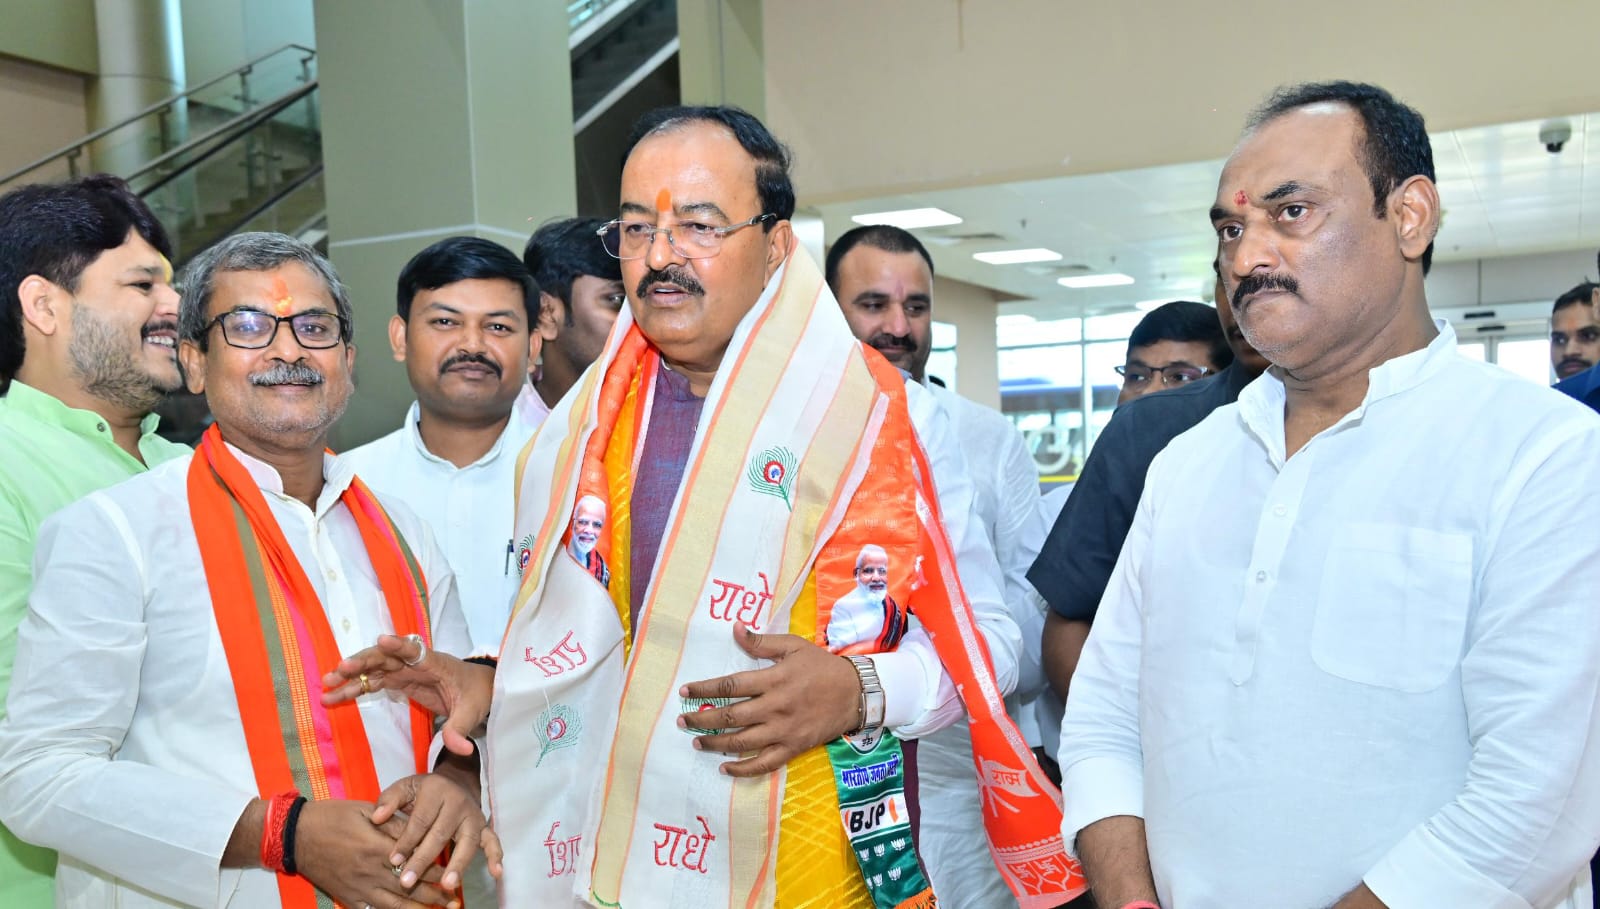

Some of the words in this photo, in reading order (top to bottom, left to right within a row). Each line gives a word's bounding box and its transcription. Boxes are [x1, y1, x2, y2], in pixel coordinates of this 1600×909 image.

[709, 571, 774, 630] राधे
[842, 764, 869, 788] भारतीय
[850, 802, 886, 833] BJP
[654, 815, 716, 874] राधे
